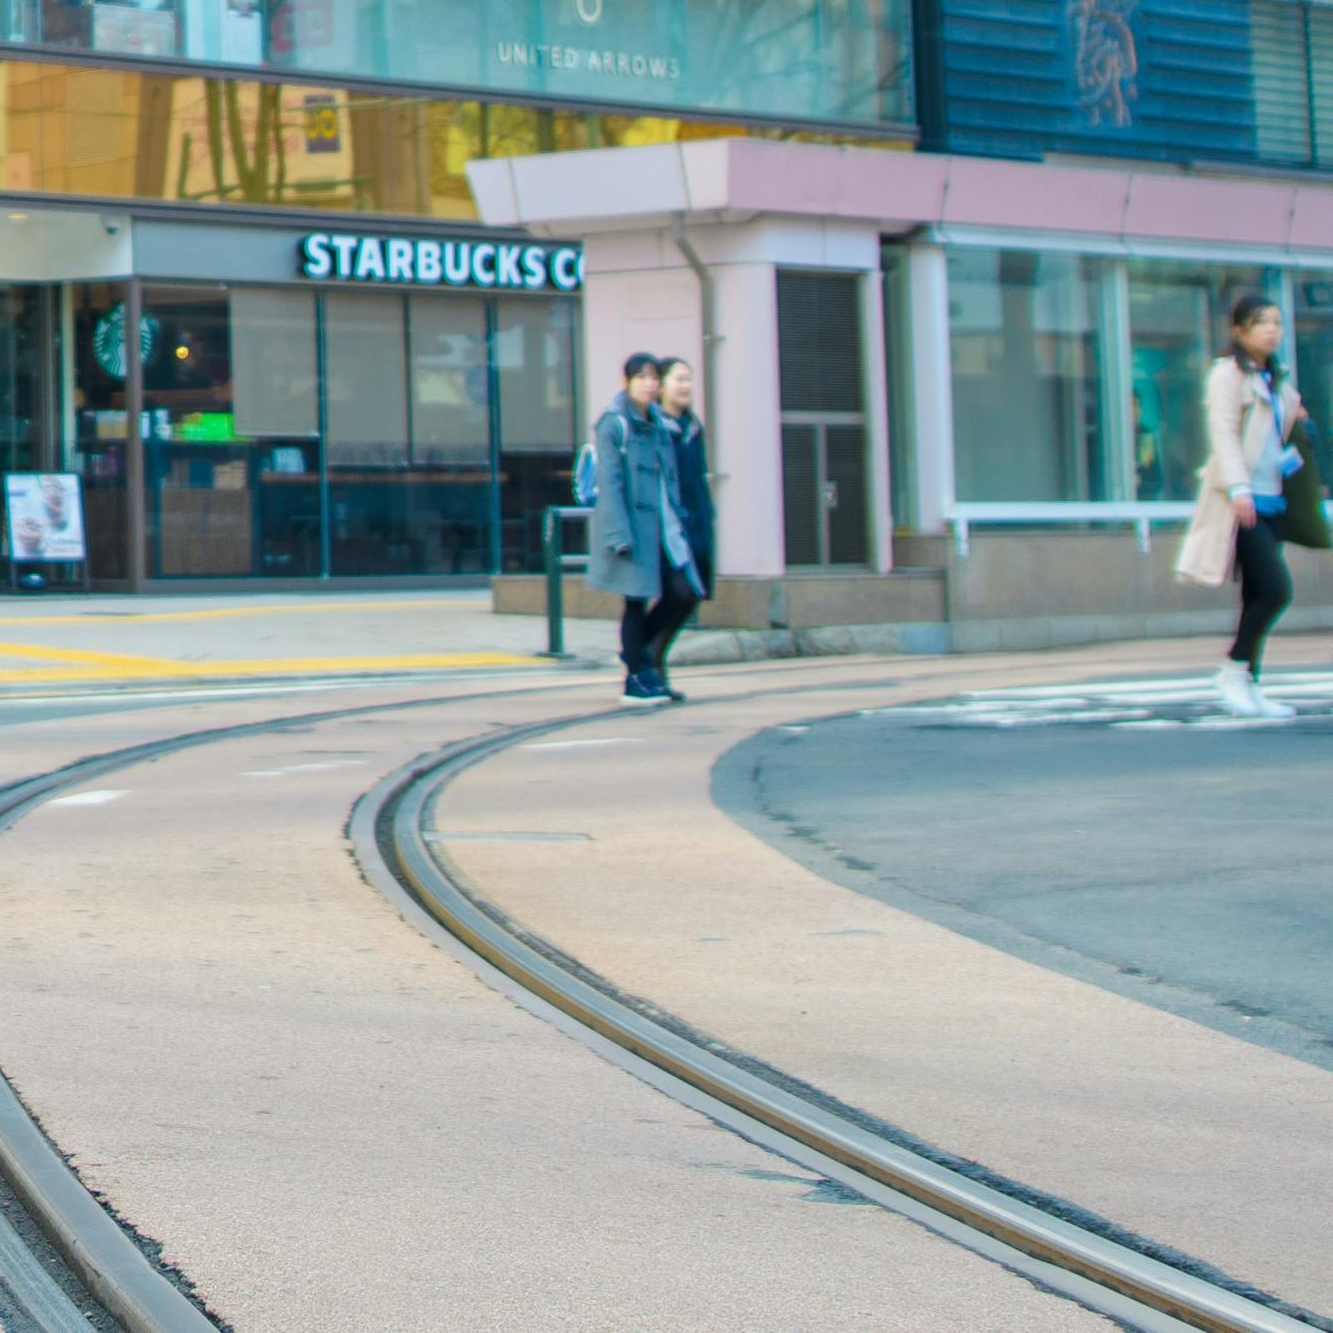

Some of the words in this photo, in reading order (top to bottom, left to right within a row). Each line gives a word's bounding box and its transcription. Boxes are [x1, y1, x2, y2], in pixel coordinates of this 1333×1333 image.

[496, 42, 577, 69] UNITED
[587, 51, 681, 80] ARROWS
[303, 233, 547, 289] STARBUCKS
[550, 248, 585, 291] C
